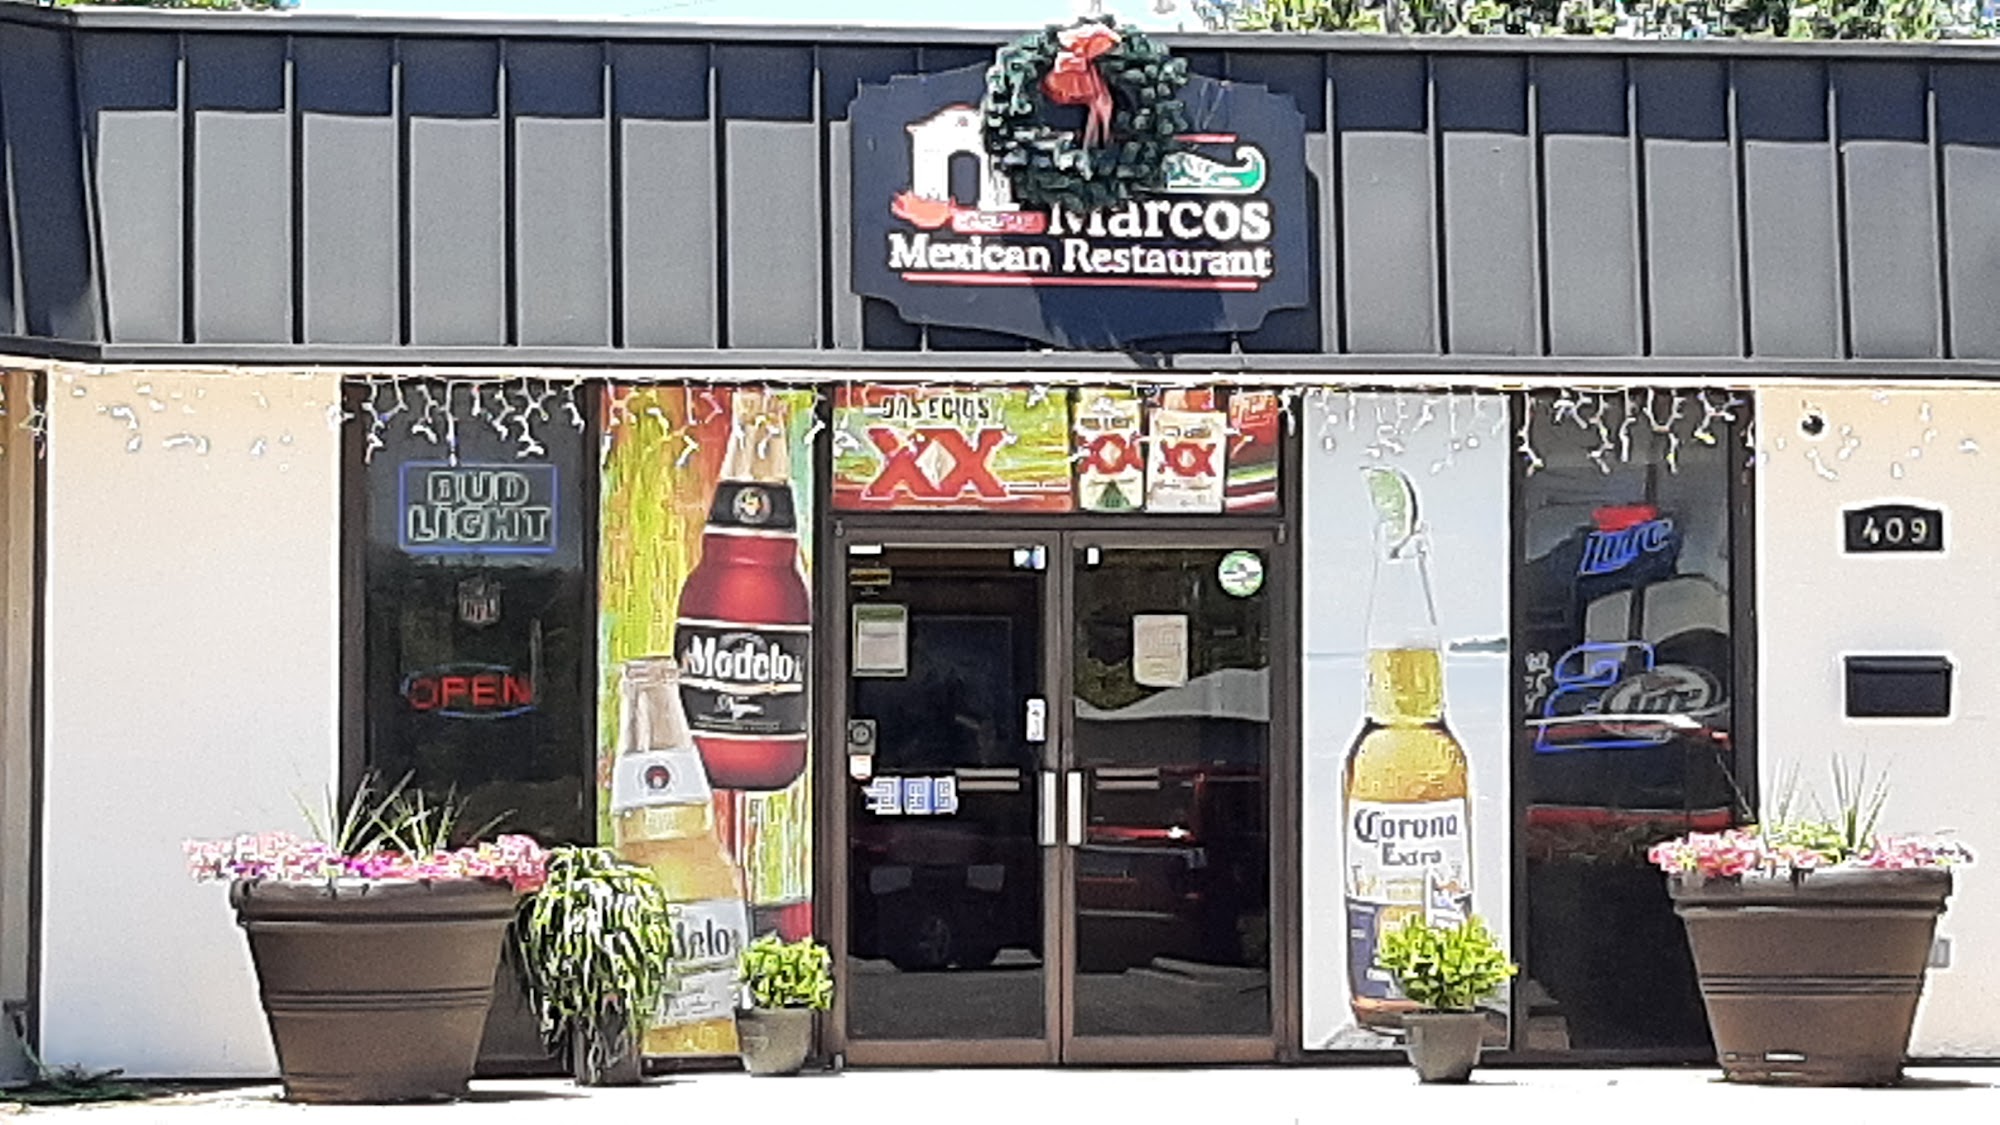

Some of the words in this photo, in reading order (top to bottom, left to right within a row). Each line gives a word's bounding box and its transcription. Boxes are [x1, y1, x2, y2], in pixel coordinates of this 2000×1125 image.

[888, 232, 1052, 274] Mexican
[1062, 237, 1273, 278] Restaurant
[860, 427, 1008, 499] XX
[427, 471, 530, 506] BUD
[407, 504, 552, 543] LIGHT
[1862, 516, 1927, 545] 409
[682, 633, 795, 682] Modelo
[409, 676, 532, 710] OPEN
[1354, 808, 1458, 848] Corona
[1381, 841, 1442, 867] Extra
